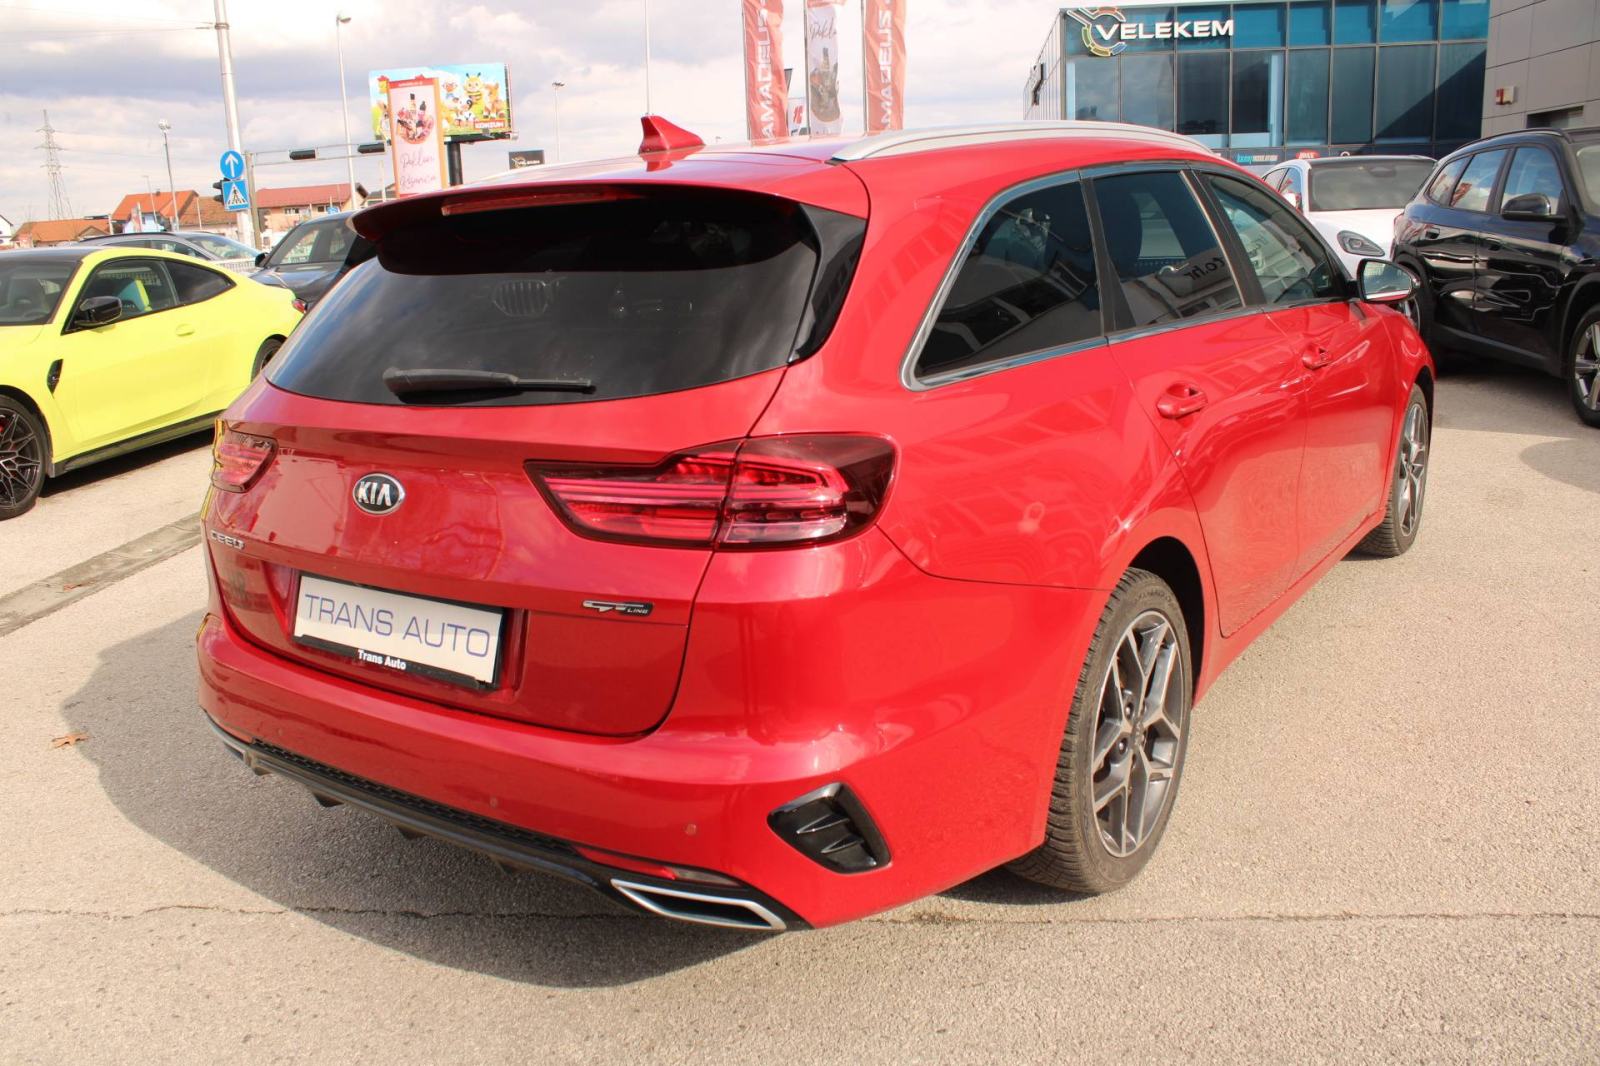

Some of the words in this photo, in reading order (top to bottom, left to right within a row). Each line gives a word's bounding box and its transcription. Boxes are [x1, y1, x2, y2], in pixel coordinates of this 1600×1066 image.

[1096, 20, 1234, 40] VELEKEM
[757, 8, 775, 138] AMADEUS
[878, 10, 893, 130] MADEUS
[357, 481, 392, 506] KIA
[304, 594, 394, 636] TRANS
[402, 616, 490, 658] AUTO
[357, 649, 383, 665] Trans
[384, 656, 407, 670] Auto
